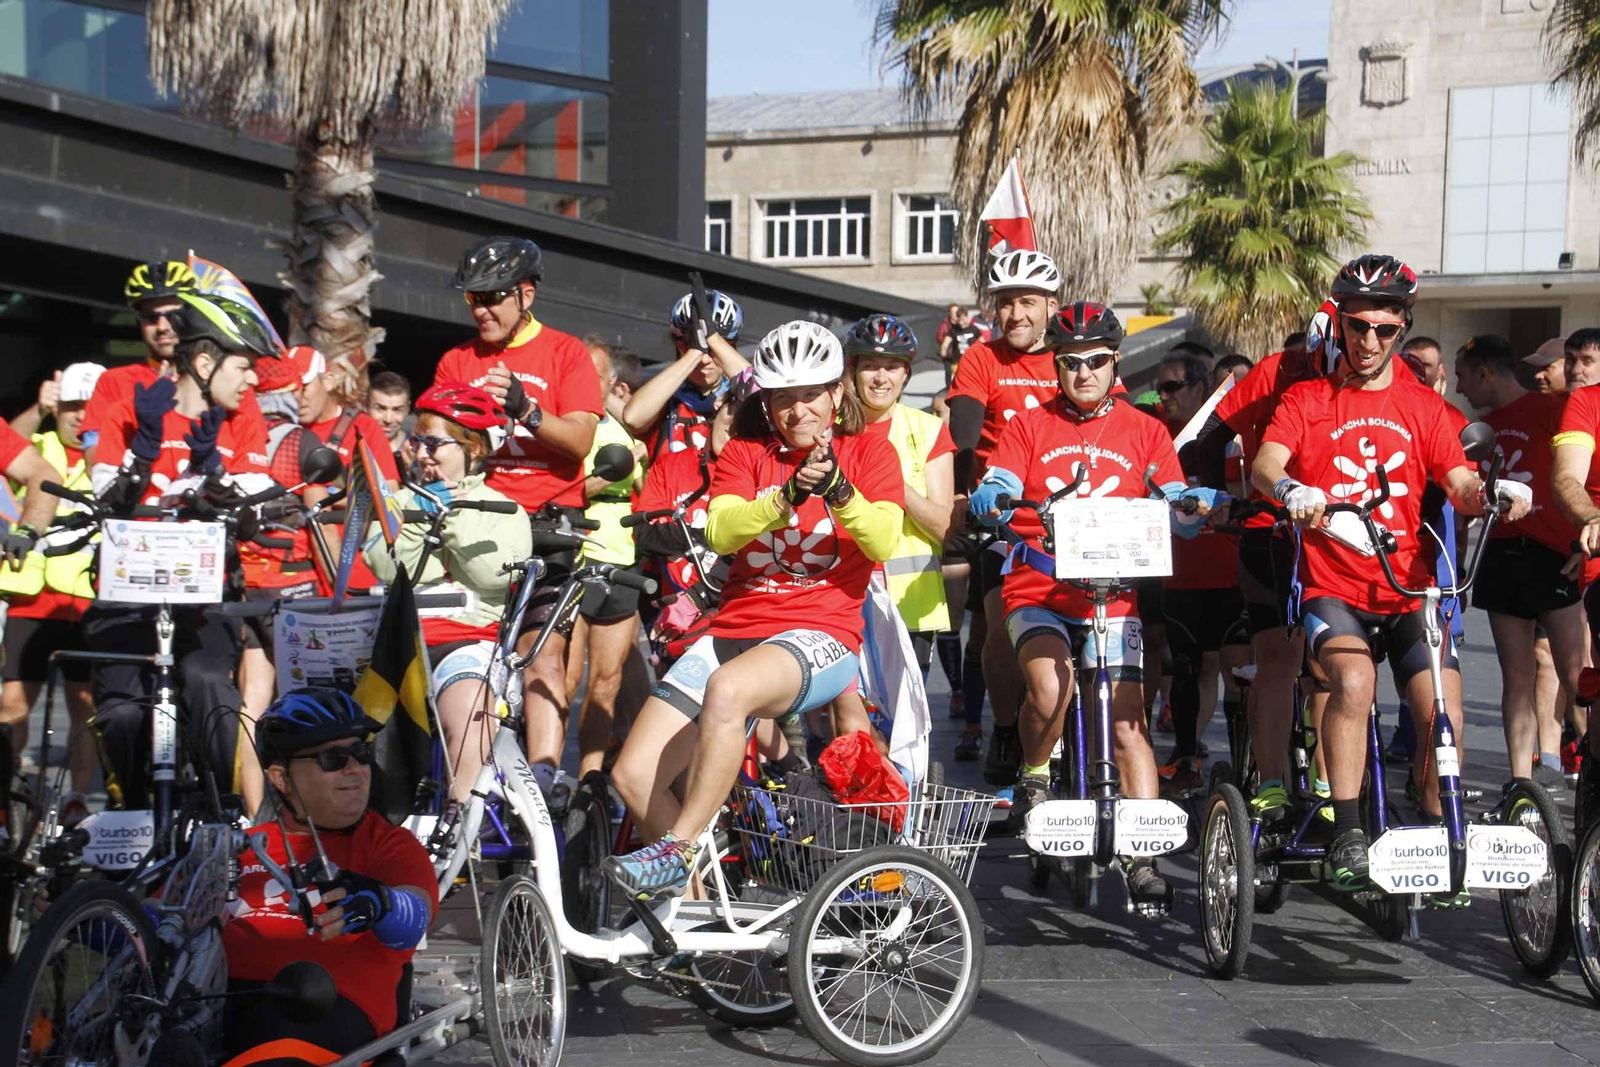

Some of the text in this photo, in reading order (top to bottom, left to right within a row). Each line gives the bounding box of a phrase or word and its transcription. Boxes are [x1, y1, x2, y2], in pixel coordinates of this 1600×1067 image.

[1005, 378, 1038, 387] MARCHA
[1330, 417, 1413, 443] MARCHA SOLIDARIA
[1040, 445, 1133, 471] MARCHA SOLIDARIA
[796, 631, 829, 648] Ciclo
[513, 758, 551, 828] Monty
[1047, 814, 1095, 827] turbo10
[1139, 814, 1188, 827] turbo10
[100, 825, 154, 839] turbo10
[1041, 840, 1085, 852] VIGO
[1131, 840, 1175, 852] VIGO
[1394, 844, 1448, 858] turbo10
[1491, 841, 1545, 855] turbo10
[94, 851, 142, 865] VIGO
[1391, 873, 1439, 888] VIGO
[1482, 870, 1531, 884] VIGO
